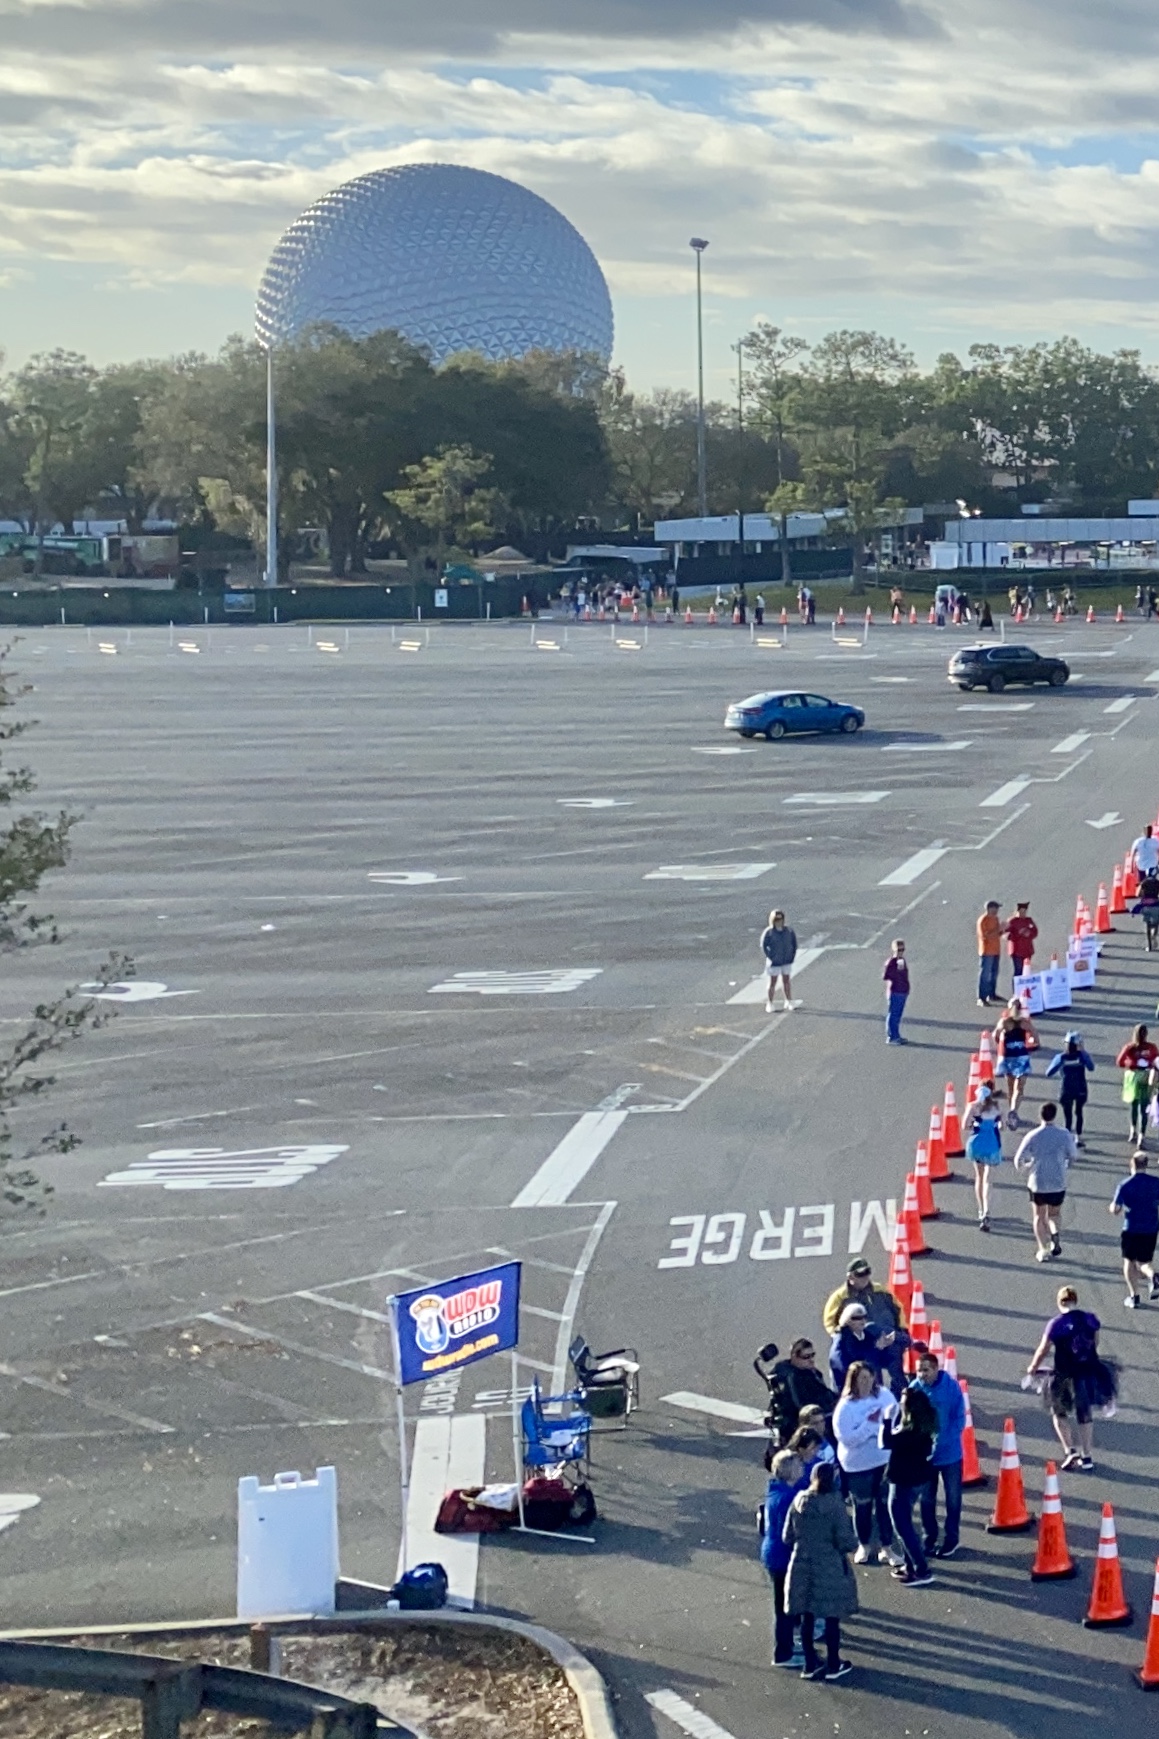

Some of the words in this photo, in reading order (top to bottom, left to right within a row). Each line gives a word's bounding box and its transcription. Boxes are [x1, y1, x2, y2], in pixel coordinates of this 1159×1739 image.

[657, 1198, 897, 1269] MERGE
[444, 1281, 501, 1321] WDW
[452, 1307, 495, 1336] RADIO
